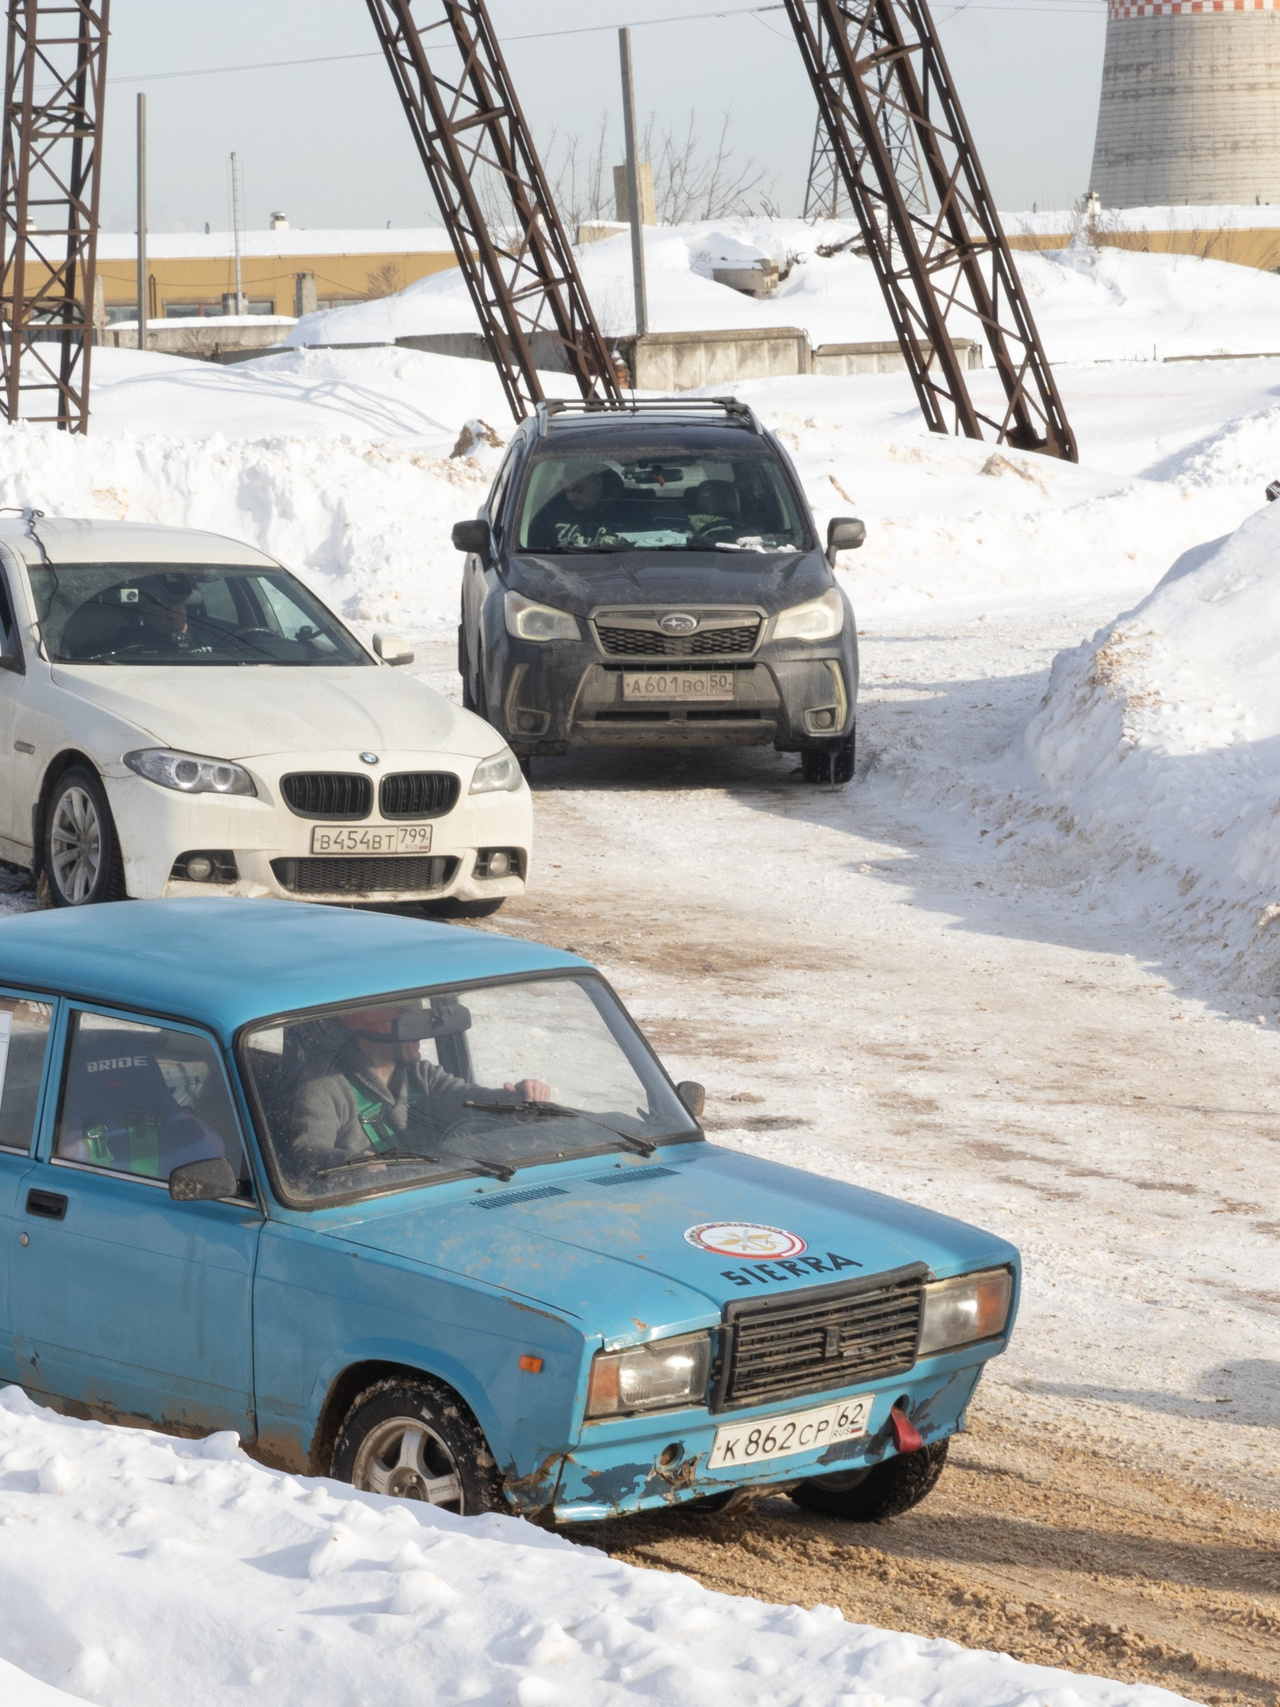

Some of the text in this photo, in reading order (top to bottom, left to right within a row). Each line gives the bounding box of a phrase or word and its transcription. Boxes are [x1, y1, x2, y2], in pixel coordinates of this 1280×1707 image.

[631, 676, 704, 694] А601ВО
[710, 674, 728, 688] 50
[320, 828, 427, 850] В454ВТ 799
[86, 1055, 148, 1073] BRIDE
[720, 1252, 863, 1286] SIERRA
[723, 1403, 863, 1461] К862СР 62
[832, 1427, 851, 1438] RUS
